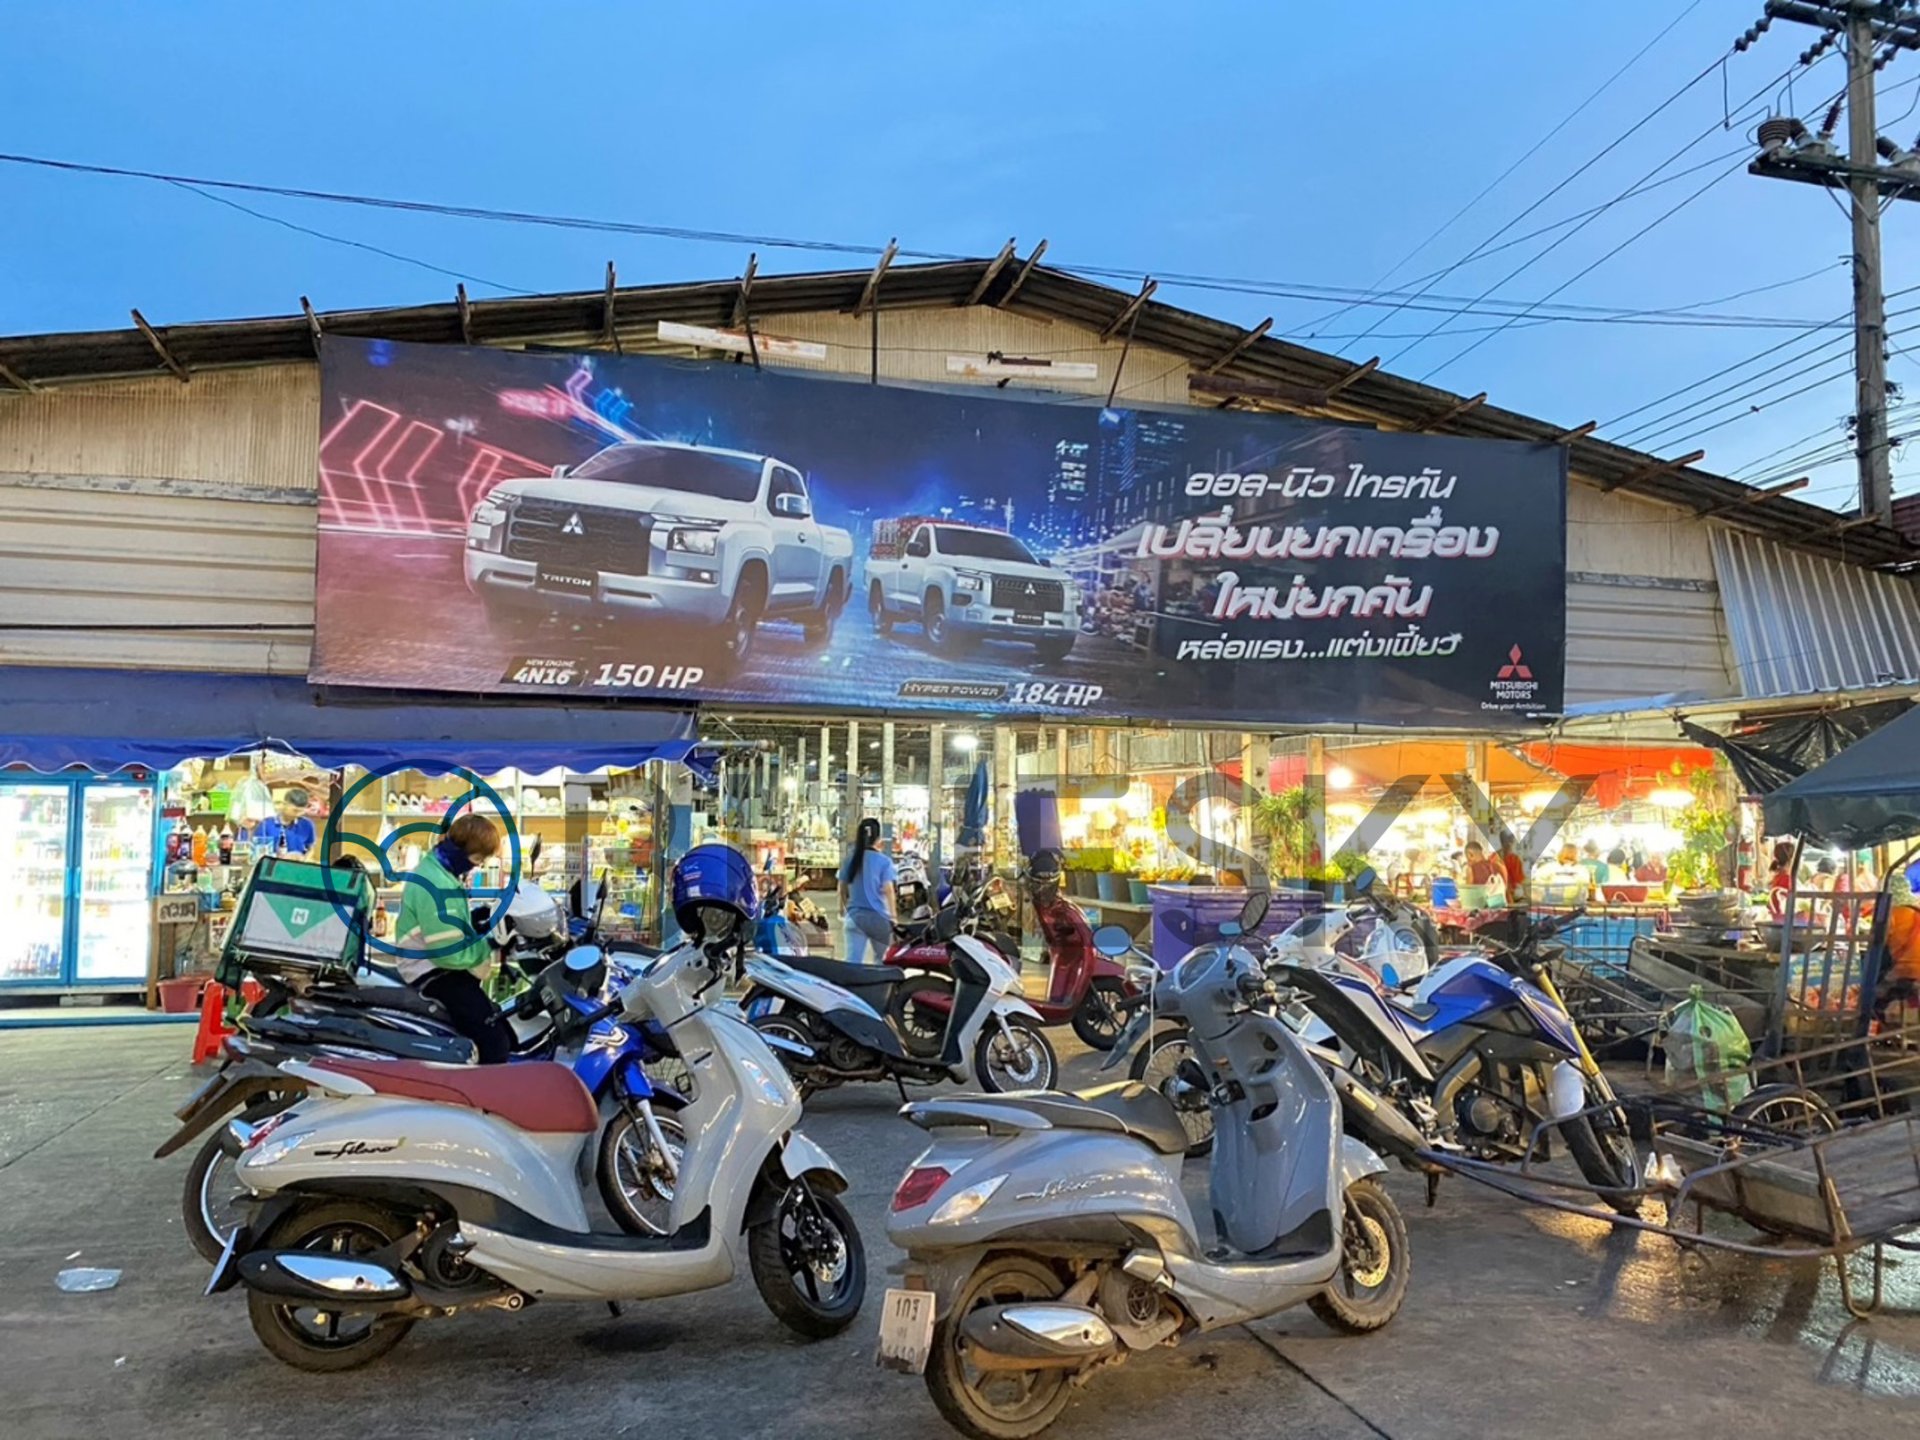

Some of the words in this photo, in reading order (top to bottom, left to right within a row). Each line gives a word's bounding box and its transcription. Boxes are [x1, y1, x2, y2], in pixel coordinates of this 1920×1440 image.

[1185, 467, 1335, 498] ออล-นิว
[1344, 463, 1457, 499] ไทรทัน
[1137, 505, 1499, 560] เปลี่ยนยกเครื่อง
[541, 573, 592, 587] TRITON
[1212, 571, 1434, 619] ใหม่ยกคัน
[525, 658, 547, 667] NEW
[513, 668, 574, 685] 4N16
[593, 663, 655, 687] 150
[657, 666, 704, 689] HP
[903, 682, 950, 694] HYPER
[950, 685, 1000, 697] POWER
[1490, 681, 1539, 690] MITSUBISHI
[1009, 682, 1061, 705] 184
[1063, 685, 1104, 707] HP
[1496, 690, 1532, 699] MOTORS
[1481, 701, 1498, 710] Drive
[1499, 703, 1515, 712] your
[1515, 702, 1547, 710] Ambition
